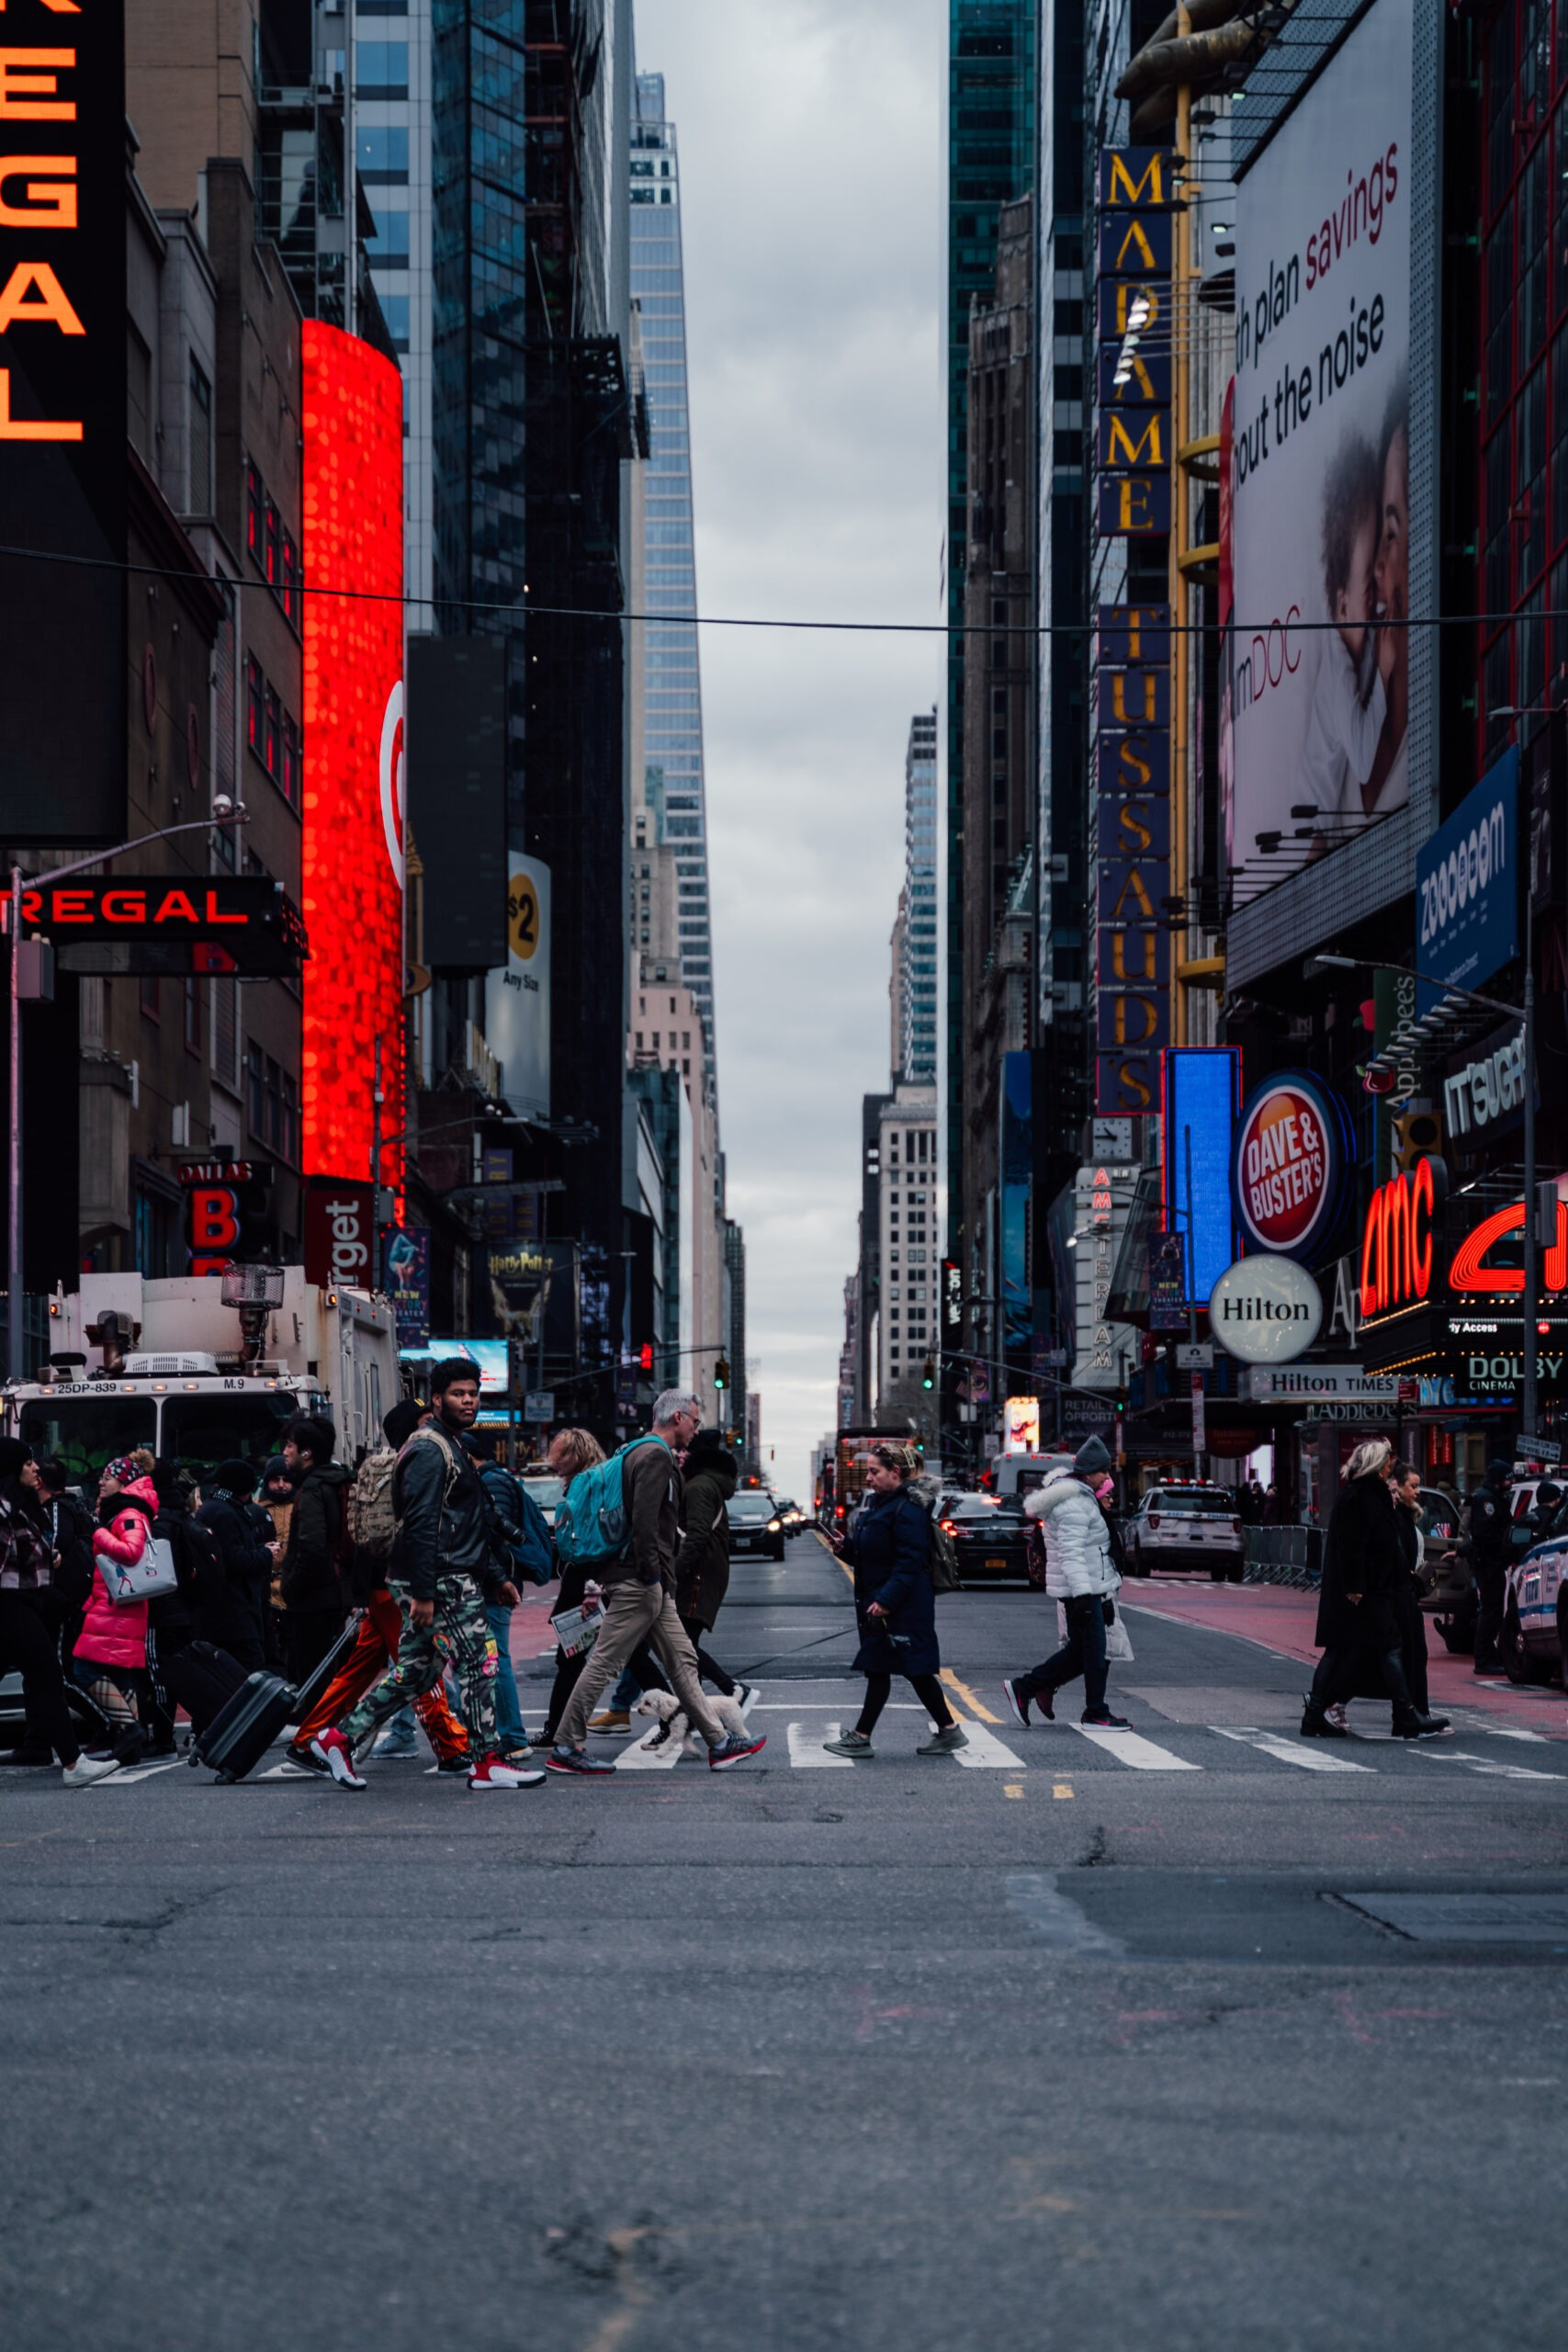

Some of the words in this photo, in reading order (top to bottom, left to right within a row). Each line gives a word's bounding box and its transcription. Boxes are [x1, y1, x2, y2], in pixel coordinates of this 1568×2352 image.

[0, 0, 86, 441] EGAL
[1255, 254, 1299, 369] plan
[1305, 142, 1398, 290] savings
[1106, 152, 1166, 530] MADAME
[1274, 365, 1312, 447] the
[1319, 293, 1385, 405] noise
[1109, 606, 1160, 1109] TUSSAUD'S
[0, 889, 249, 923] REGAL
[503, 971, 522, 991] Any
[524, 974, 539, 992] Size
[1385, 975, 1421, 1107] Appbee's
[1247, 1115, 1303, 1185] DAVE
[1300, 1112, 1319, 1152] &
[177, 1161, 253, 1184] DALLAS
[1250, 1152, 1323, 1222] BUSTER'S
[488, 1254, 520, 1276] Harry
[394, 1290, 420, 1300] NEW
[1223, 1297, 1310, 1321] Hilton
[1462, 1322, 1497, 1333] Access
[1469, 1357, 1564, 1380] DOLBY
[58, 1384, 117, 1395] 25DP-839
[1271, 1374, 1337, 1392] Hilton
[1346, 1378, 1394, 1391] TIMES
[1469, 1381, 1517, 1391] CINEMA
[1065, 1399, 1104, 1411] RETAIL
[492, 1439, 531, 1464] Hrry
